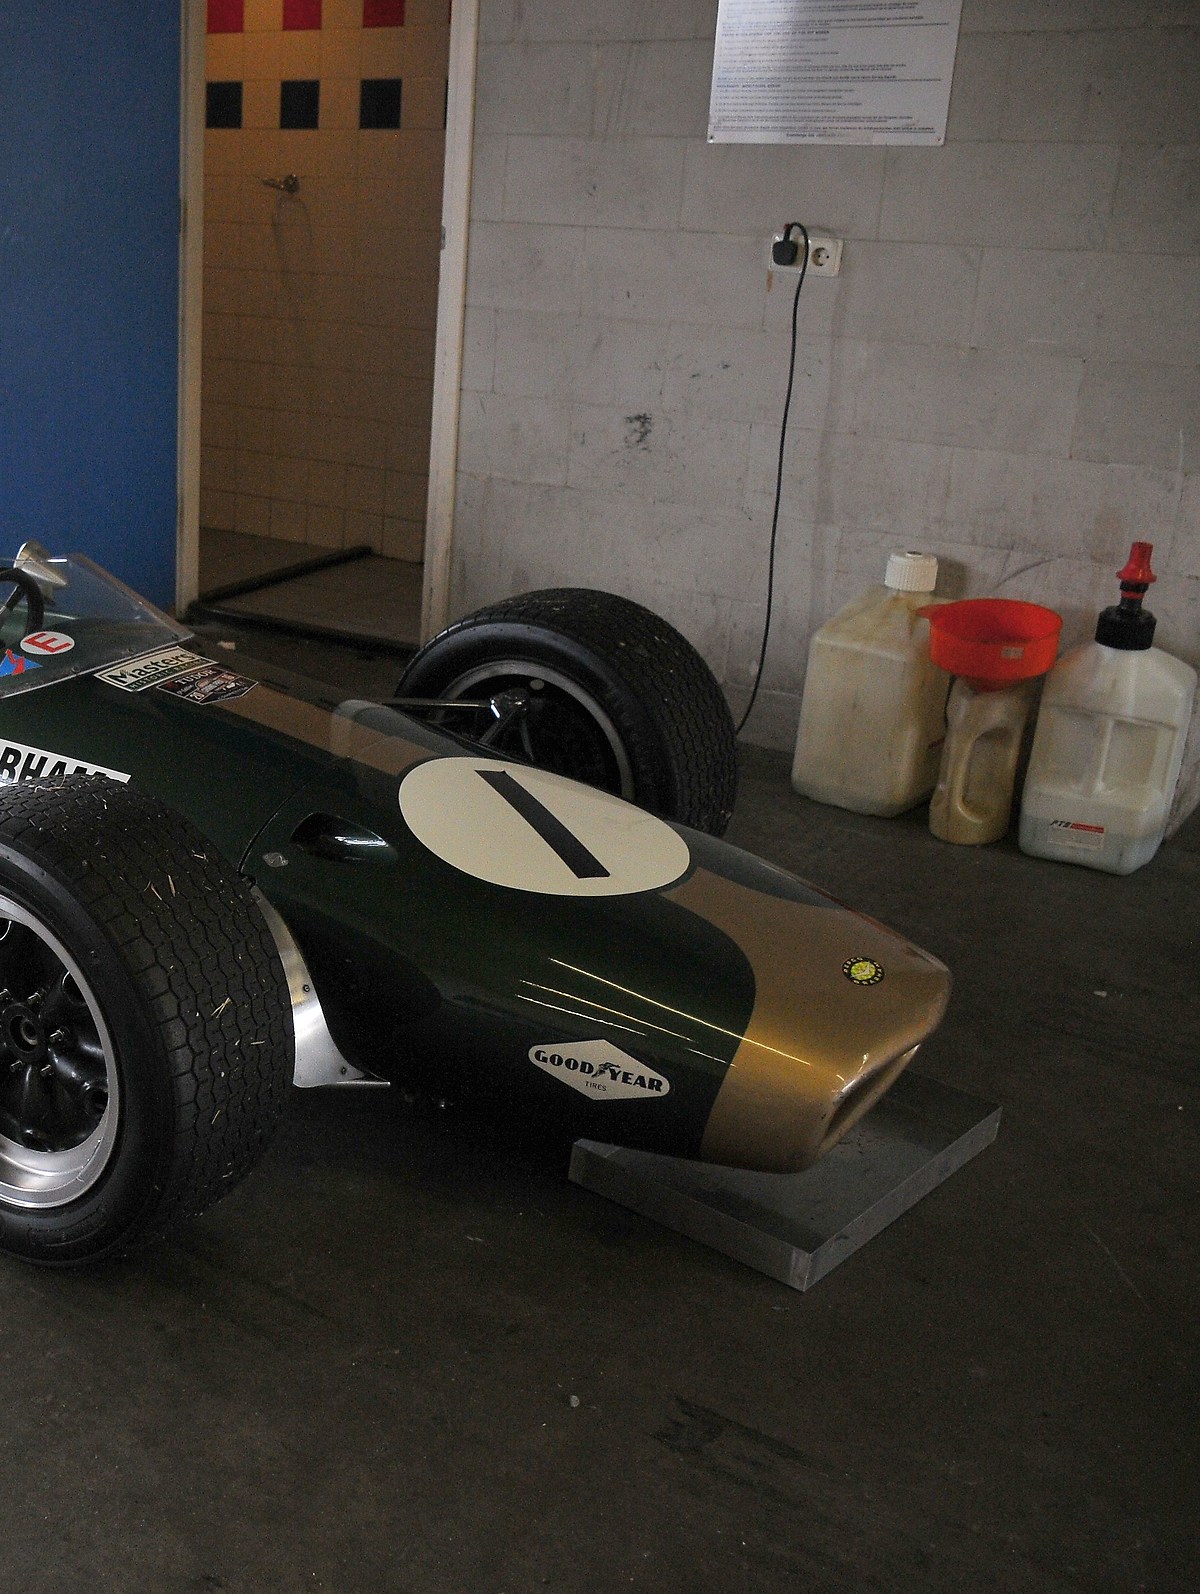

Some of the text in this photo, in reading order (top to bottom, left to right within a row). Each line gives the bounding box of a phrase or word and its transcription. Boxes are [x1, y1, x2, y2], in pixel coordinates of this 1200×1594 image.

[23, 632, 72, 653] E
[107, 652, 196, 684] Masters
[174, 668, 219, 685] TUDOR
[474, 770, 610, 878] 1
[585, 1080, 607, 1092] TIRES
